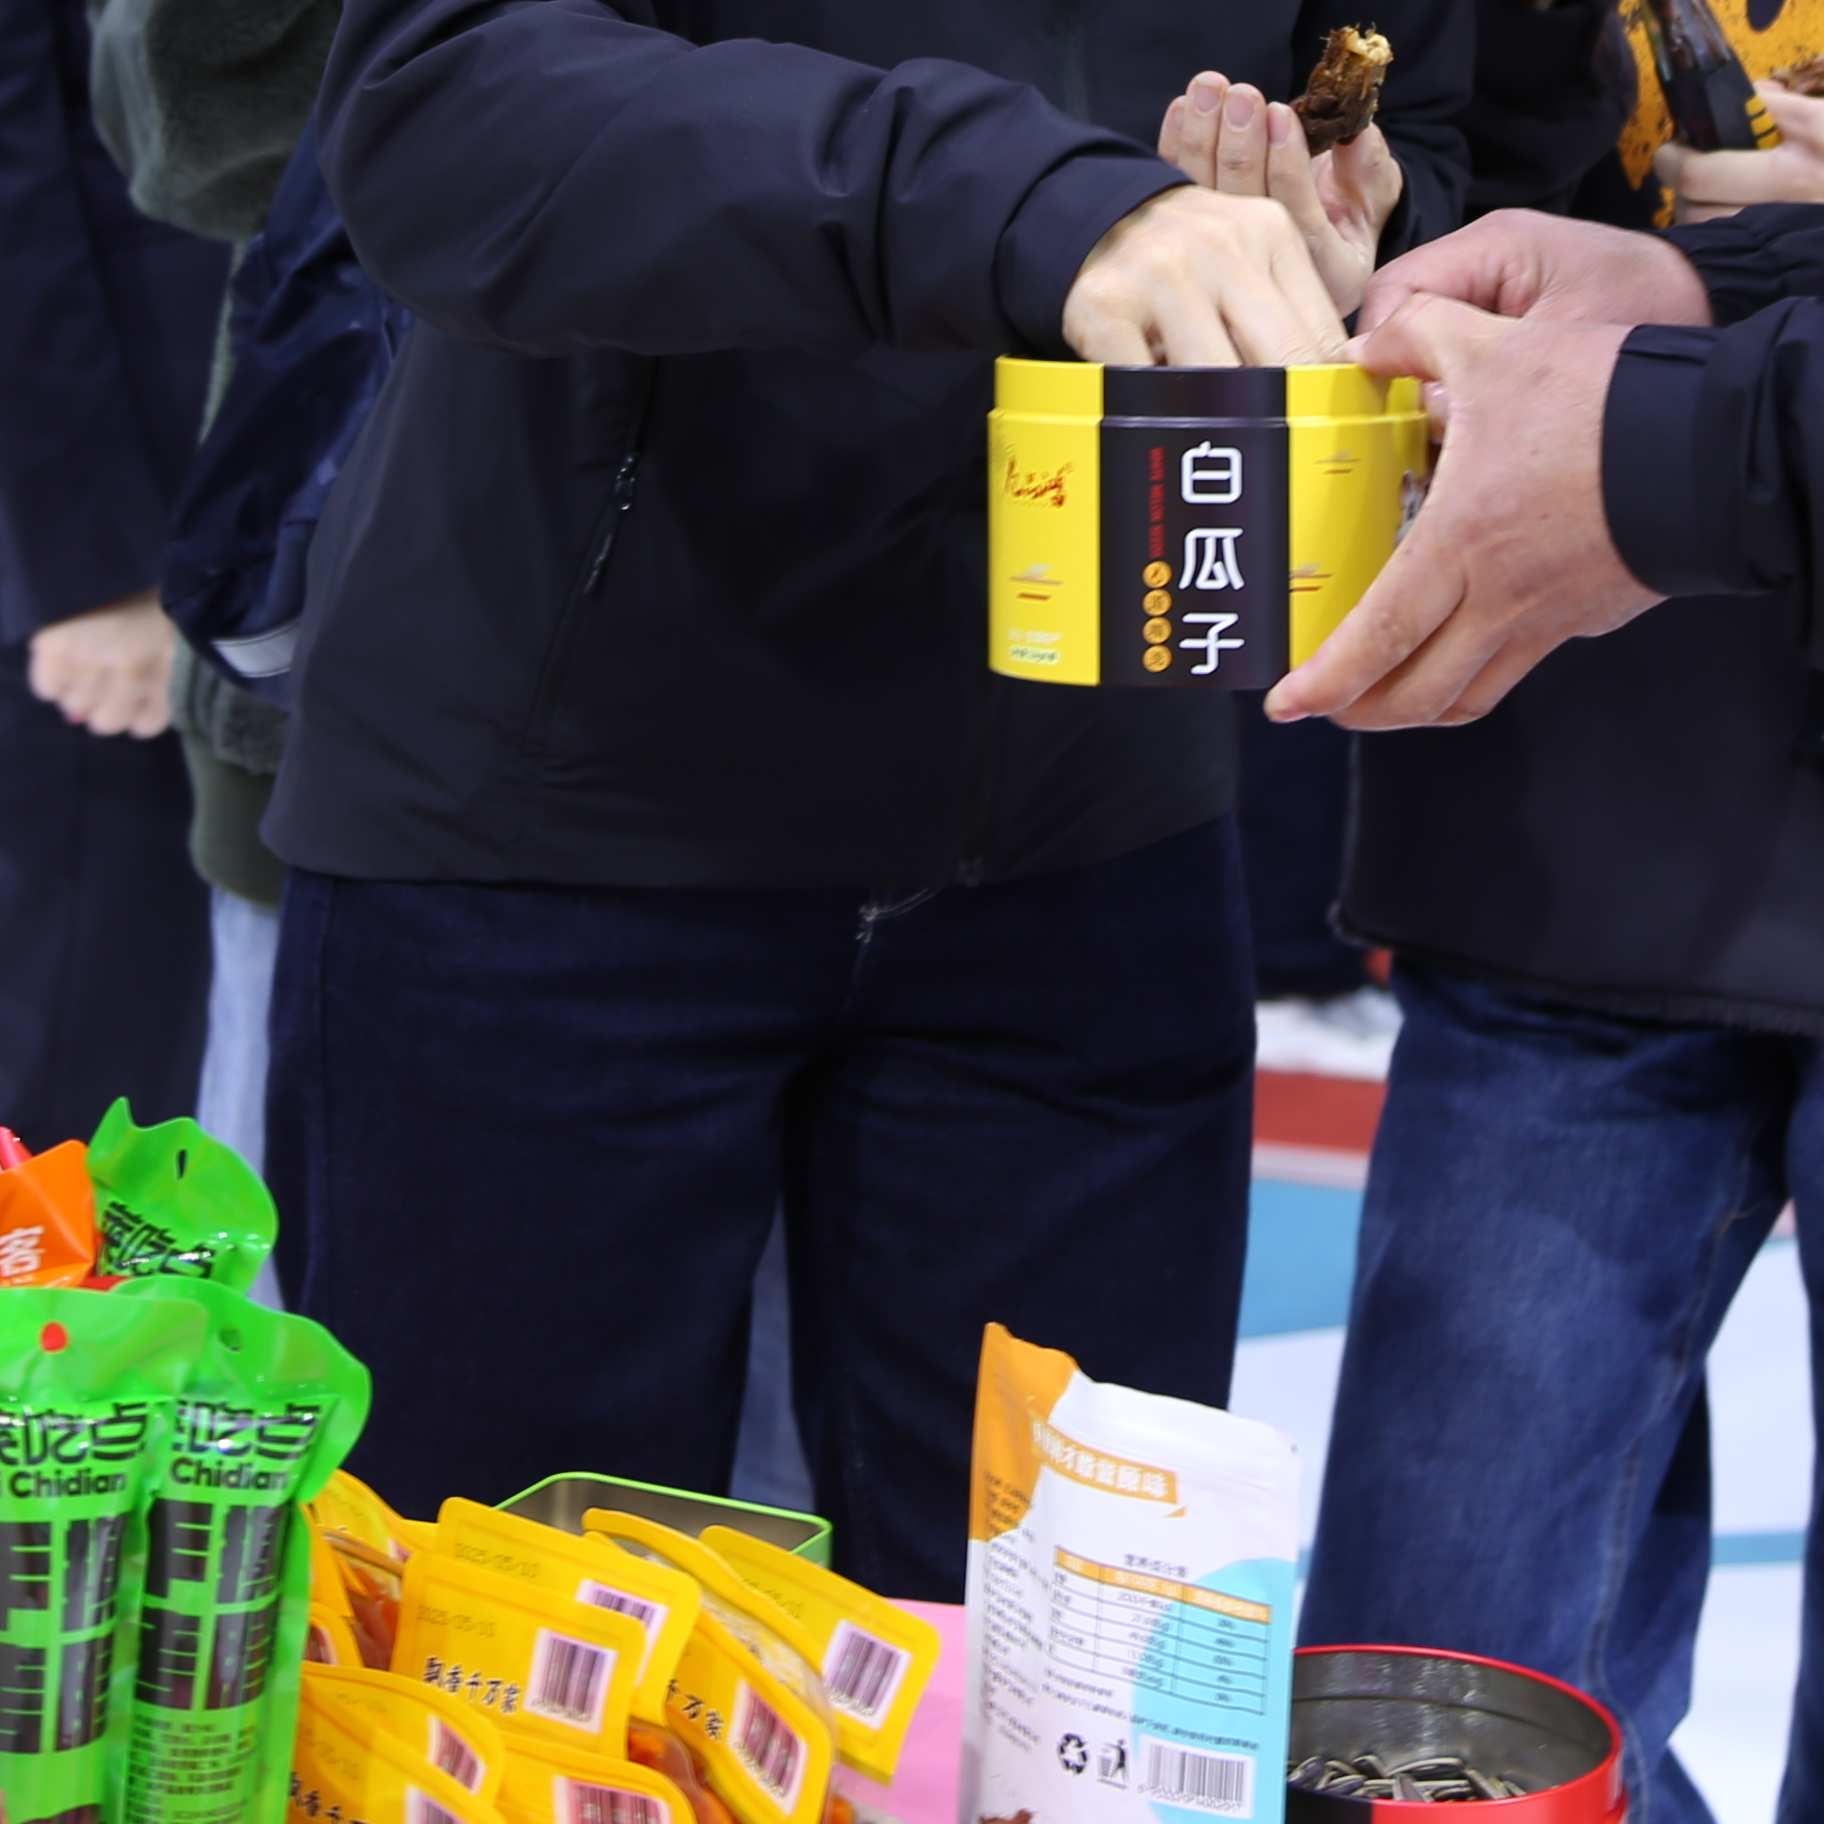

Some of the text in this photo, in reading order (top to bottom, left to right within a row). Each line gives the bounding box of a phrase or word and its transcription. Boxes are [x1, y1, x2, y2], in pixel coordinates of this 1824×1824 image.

[1179, 440, 1244, 675] 白瓜子
[172, 1398, 322, 1461] 吃点
[10, 1466, 127, 1499] Chidian
[170, 1457, 289, 1492] Chidian
